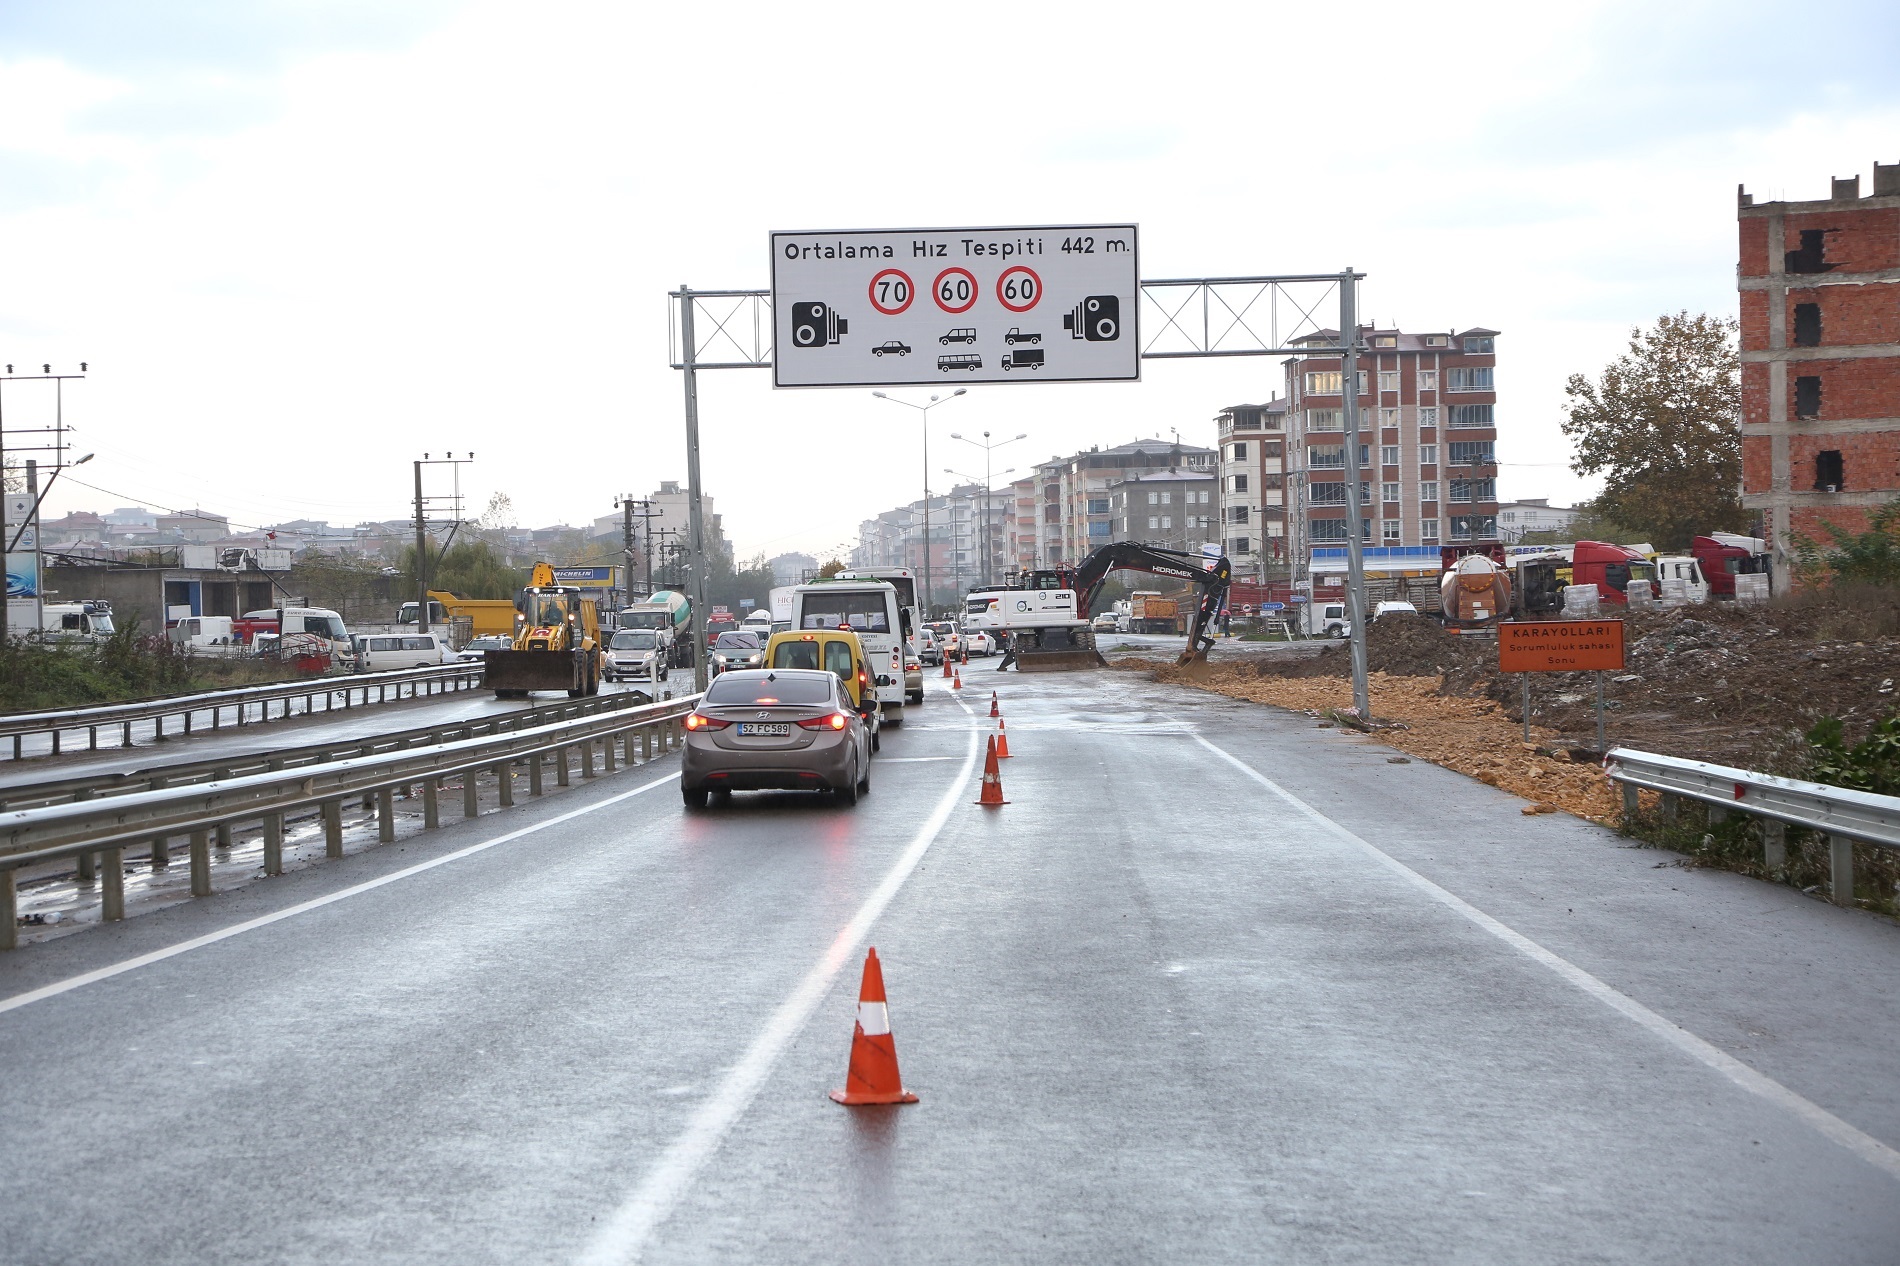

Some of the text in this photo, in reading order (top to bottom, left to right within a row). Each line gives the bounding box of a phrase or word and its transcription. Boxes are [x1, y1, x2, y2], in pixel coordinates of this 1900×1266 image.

[785, 236, 1130, 261] Ortalama Hız Tespiti 442 m.
[878, 281, 907, 302] 70
[941, 279, 970, 301] 60
[1004, 278, 1034, 300] 60
[1515, 547, 1545, 555] BEST
[1513, 627, 1610, 637] KARAYOLLARI
[1509, 643, 1575, 652] Sorumluluk
